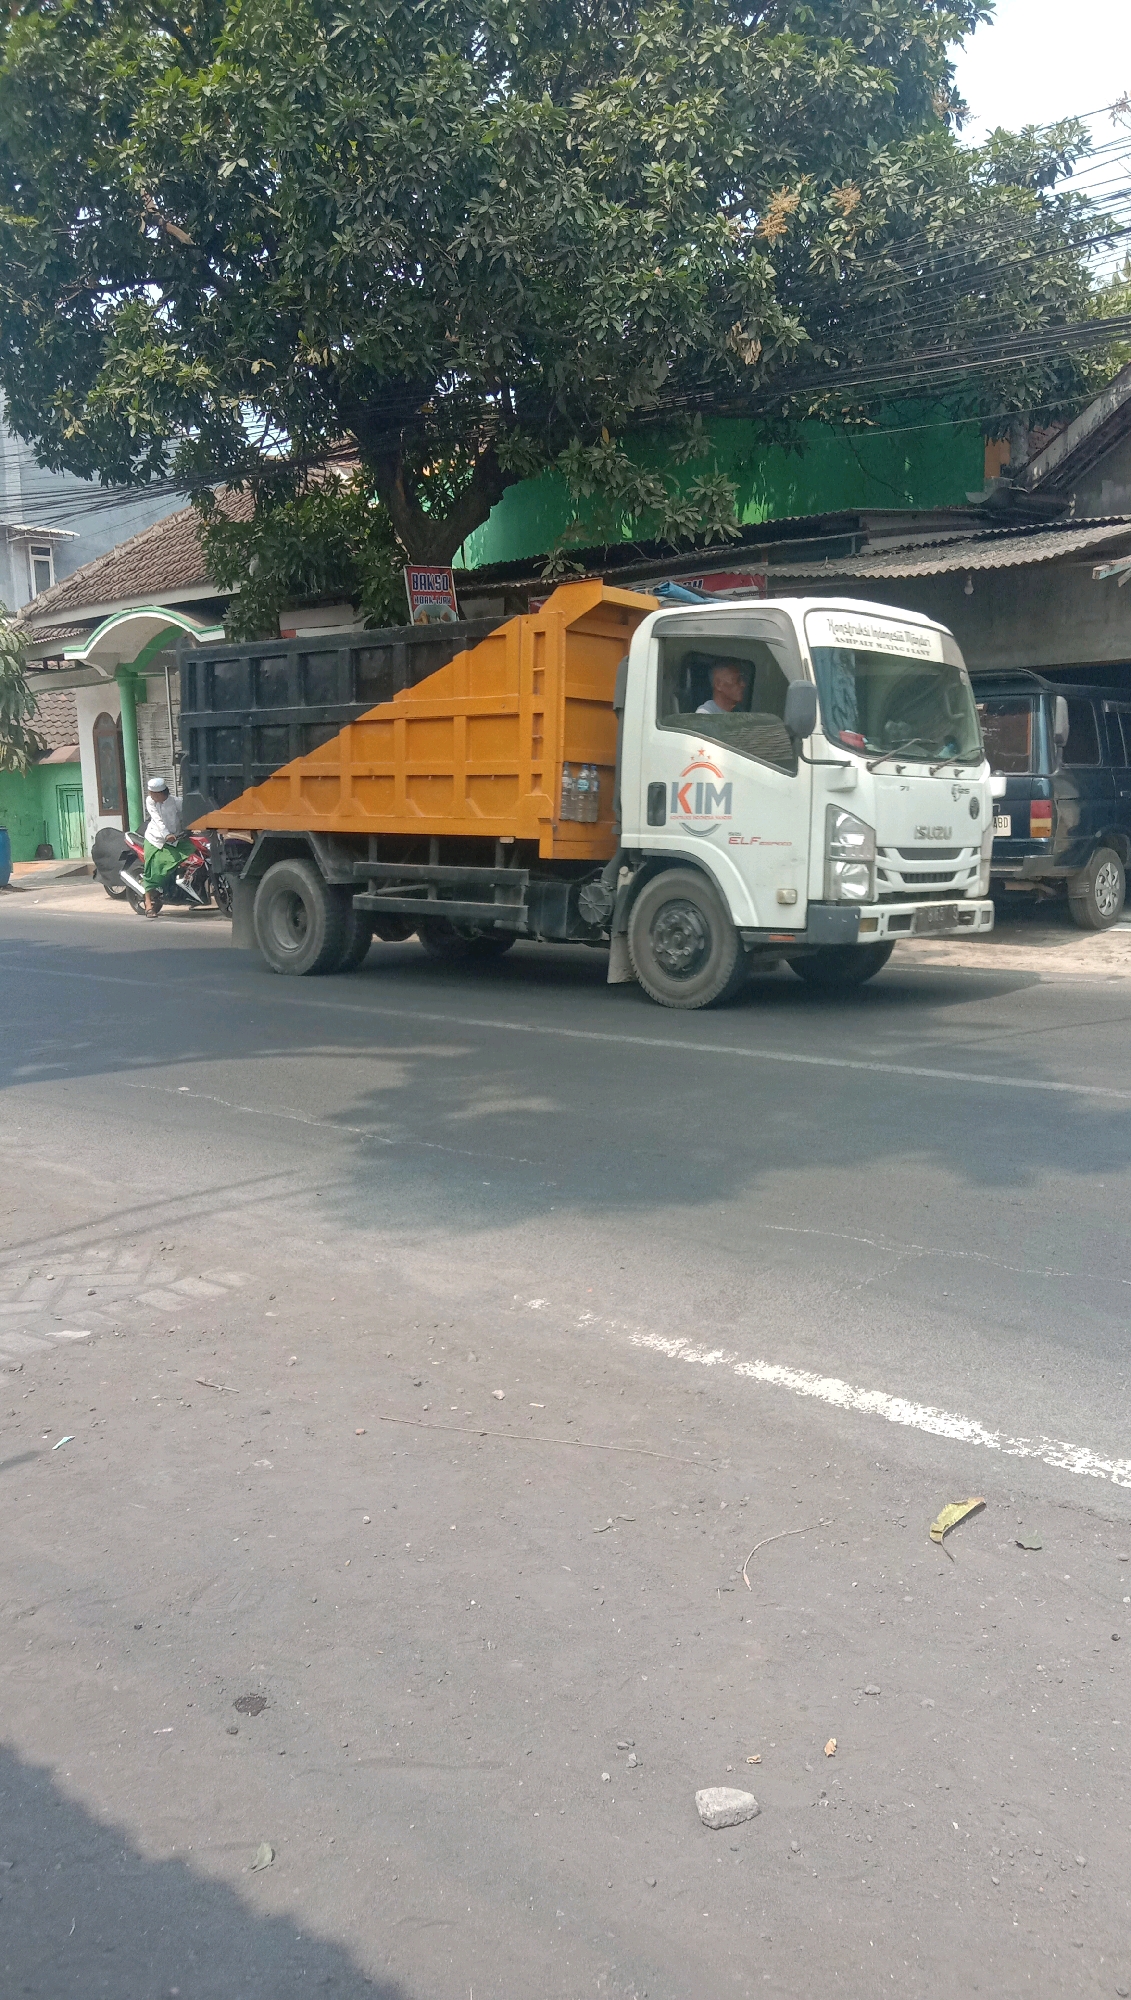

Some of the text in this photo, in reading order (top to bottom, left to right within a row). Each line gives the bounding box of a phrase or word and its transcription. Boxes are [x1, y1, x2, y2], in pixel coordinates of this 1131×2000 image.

[411, 573, 449, 592] BAKSO
[670, 782, 733, 814] KIM
[728, 836, 762, 846] ELF
[913, 825, 953, 841] ISUZU
